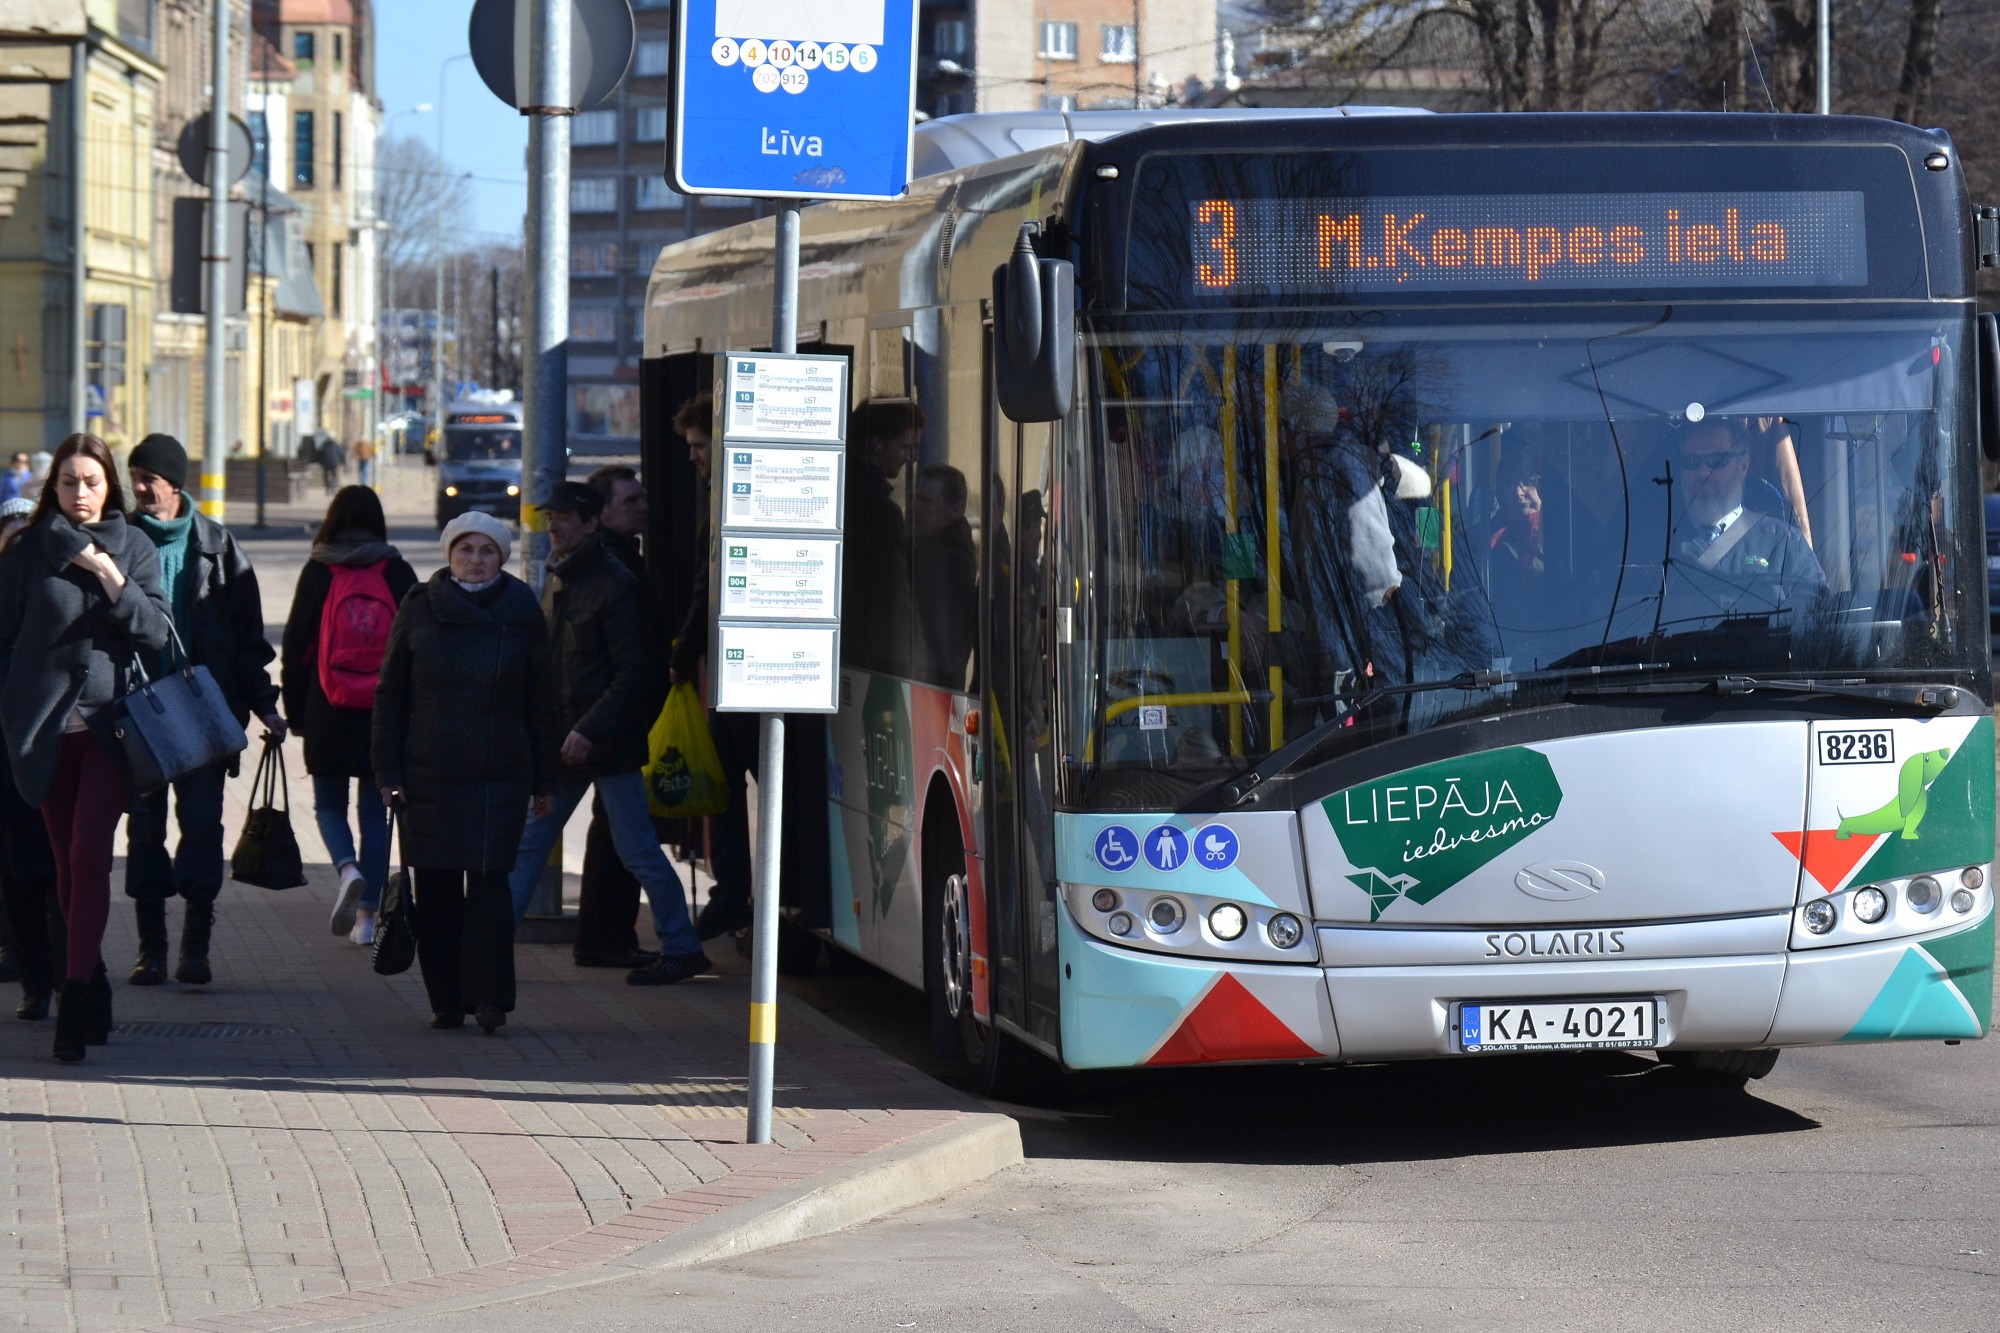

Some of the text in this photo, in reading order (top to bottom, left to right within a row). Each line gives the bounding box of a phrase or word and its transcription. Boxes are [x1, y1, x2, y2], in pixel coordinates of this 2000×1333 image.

[720, 45, 868, 65] 3 4 10 14 15 6
[755, 72, 805, 85] 702 912
[761, 126, 823, 157] Līva
[1198, 200, 1236, 287] 3
[1667, 207, 1786, 264] iela
[805, 367, 819, 375] LST
[740, 393, 750, 401] 10
[804, 396, 817, 404] LST
[802, 456, 815, 464] LST
[801, 486, 814, 494] LST
[733, 548, 743, 556] 23
[730, 578, 745, 586] 904
[795, 579, 808, 587] LST
[727, 650, 743, 659] 912
[793, 651, 805, 659] LST
[1826, 733, 1888, 761] 8236
[1344, 778, 1523, 825] LIEPĀJA
[1402, 811, 1552, 862] iedvesmo
[1484, 930, 1625, 958] SOLARIS
[1488, 1005, 1645, 1041] KA-4021
[1465, 1029, 1479, 1038] LV
